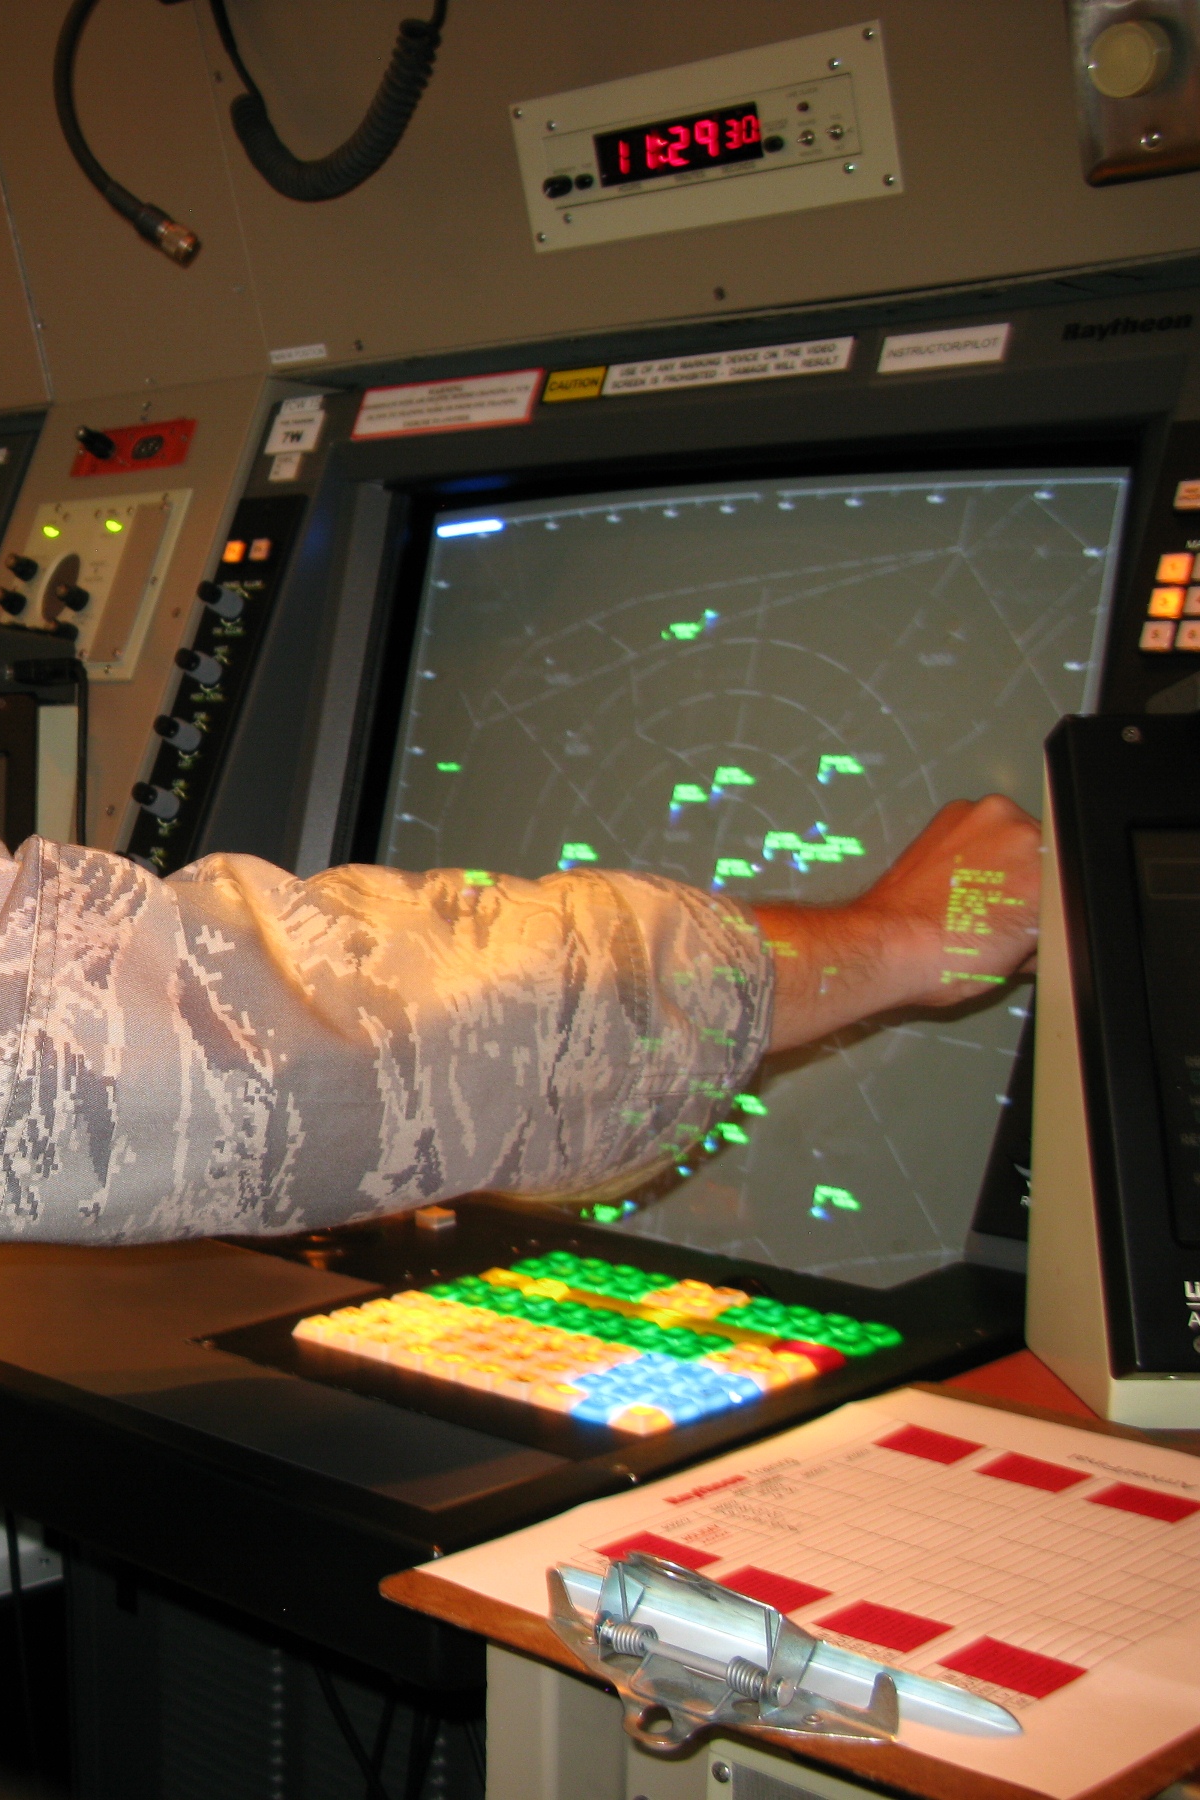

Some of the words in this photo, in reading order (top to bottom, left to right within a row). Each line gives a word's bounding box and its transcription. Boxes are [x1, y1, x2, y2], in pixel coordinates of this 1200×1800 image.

[1062, 313, 1194, 341] Raytheon
[886, 336, 1000, 359] INSTRUCTOR/PILOT
[725, 351, 760, 364] DEVICE
[729, 362, 769, 376] DAMAGE
[548, 376, 600, 392] CAUTION
